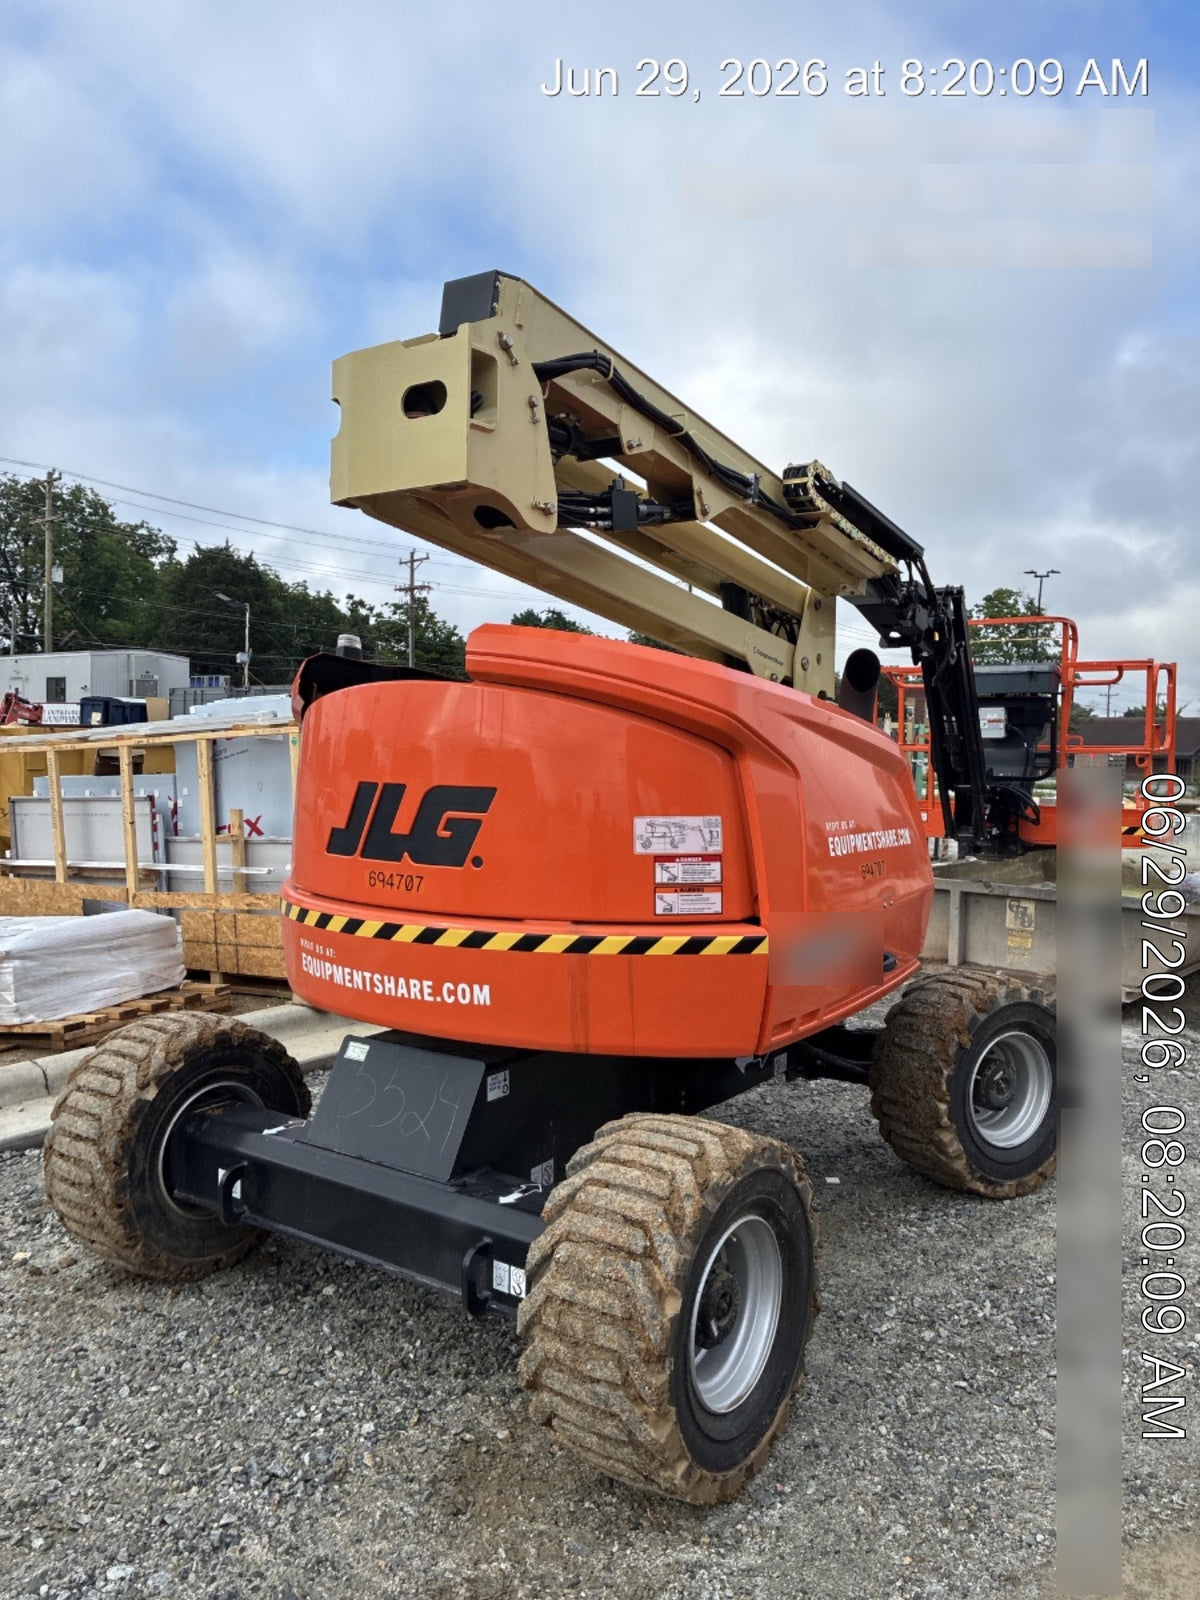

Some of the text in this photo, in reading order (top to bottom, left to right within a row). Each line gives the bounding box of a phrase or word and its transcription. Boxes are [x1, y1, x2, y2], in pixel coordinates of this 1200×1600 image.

[828, 827, 912, 857] EQUIPMENTSHARE.COM
[368, 870, 425, 893] 694707
[301, 952, 492, 1006] EQUIPMENTSHARE.COM
